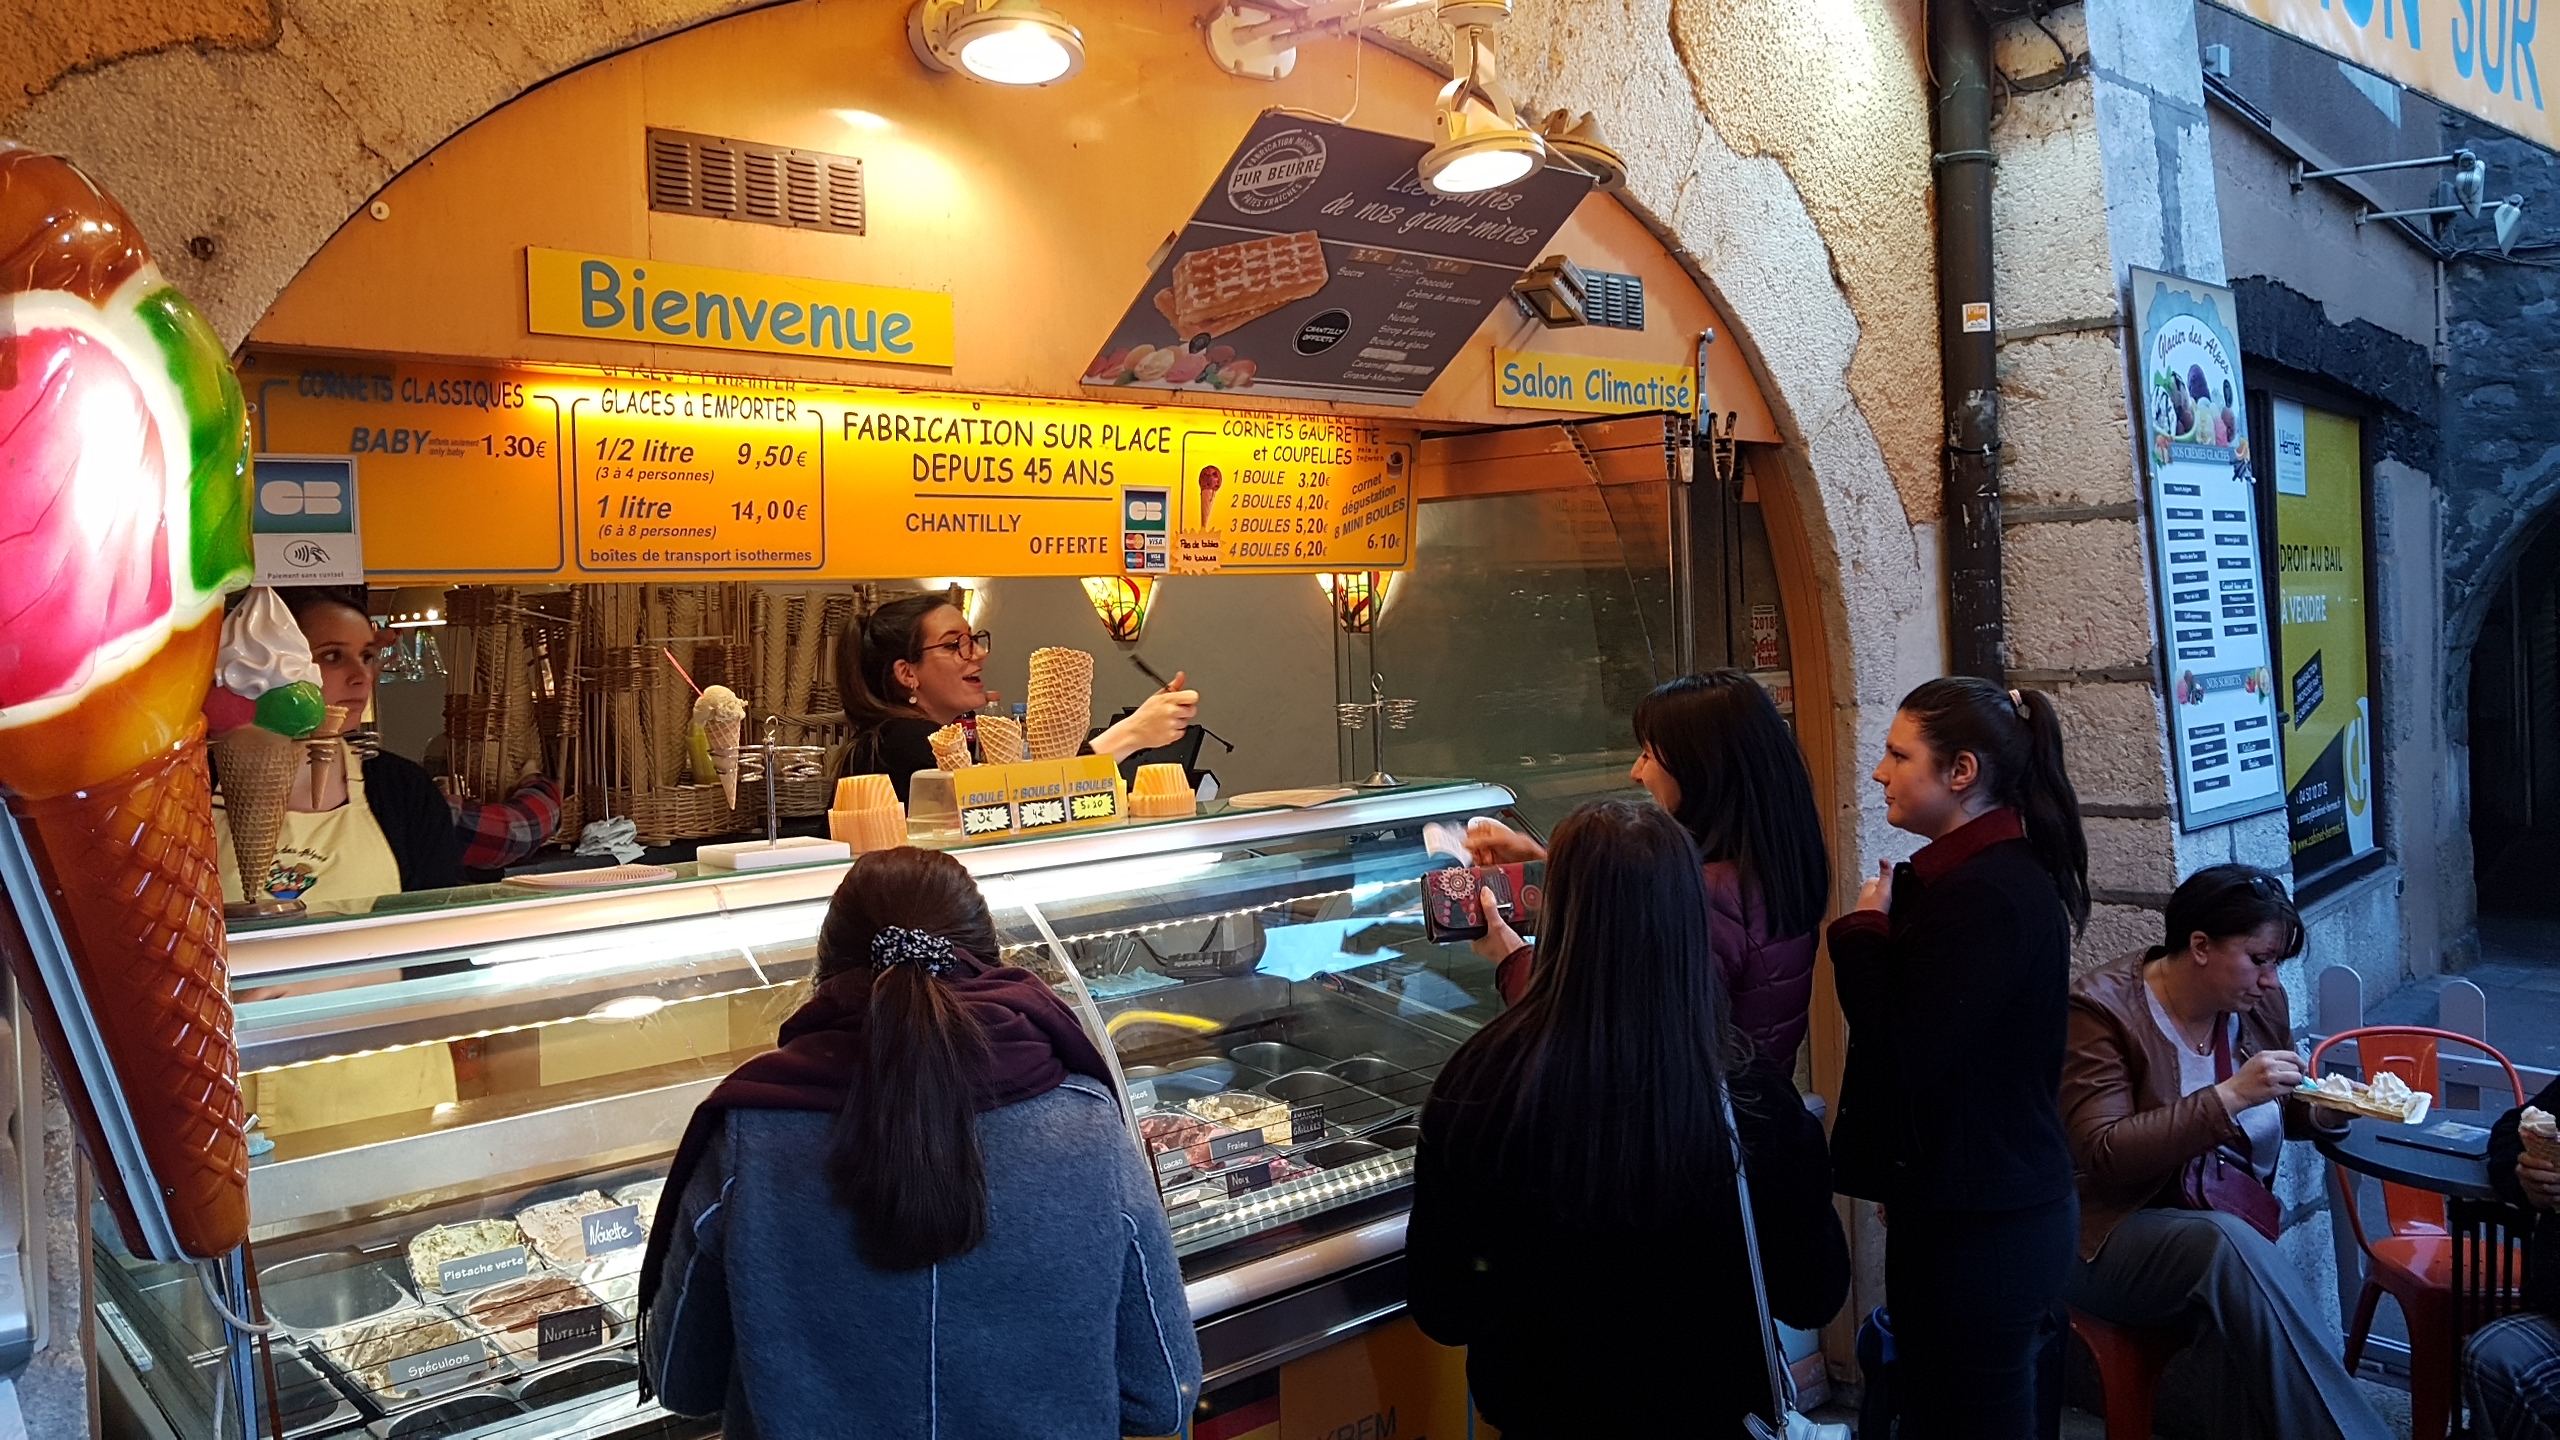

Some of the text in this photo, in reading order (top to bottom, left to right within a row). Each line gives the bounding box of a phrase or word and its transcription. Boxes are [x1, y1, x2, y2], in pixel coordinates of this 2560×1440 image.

[2452, 0, 2544, 111] SUR
[1247, 136, 1295, 167] FABRICATION
[1232, 157, 1324, 188] PUR BEURRE
[1387, 167, 1427, 196] Les
[1320, 191, 1538, 245] de nos grand-mères
[1336, 266, 1365, 278] Sucre
[1415, 276, 1454, 289] Chocolat
[1434, 292, 1445, 301] de
[580, 259, 914, 355] Bienvenue
[1397, 301, 1417, 311] Miel
[1387, 312, 1420, 324] Nutella
[1301, 334, 1337, 344] OFFERTE
[1305, 325, 1346, 336] CHANTILLY
[1378, 325, 1403, 337] Sirop
[1369, 336, 1430, 351] Boule de glace
[2157, 325, 2229, 375] Glacier des Alpes
[1351, 359, 1387, 370] Caramel
[1342, 370, 1405, 383] Grand-Marnier
[1502, 362, 1690, 408] Salon Climatisé
[401, 377, 524, 413] CLASSIQUES
[601, 387, 797, 422] GLACES à EMPORTER
[351, 426, 432, 455] BABY
[843, 411, 1172, 454] FABRICATION SUR PLACE
[1223, 419, 1380, 445] CORNETS GAUFRETTE
[595, 437, 635, 462] 1/2
[642, 438, 694, 463] litre
[1253, 446, 1352, 465] et COUPELLES
[2171, 446, 2184, 459] NOS
[595, 466, 715, 484] (3 à 4 personnes)
[912, 453, 1115, 486] DEPUIS 45 ANS
[1233, 469, 1239, 484] 1
[1242, 470, 1285, 485] BOULE
[1351, 473, 1382, 495] cornet
[596, 494, 610, 519] 1
[619, 495, 672, 519] litre
[1230, 494, 1239, 508] 2
[1241, 494, 1292, 509] BOULES
[1341, 484, 1397, 516] dégustation
[905, 512, 1021, 533] CHANTILLY
[1230, 518, 1238, 533] 3
[1240, 518, 1291, 533] BOULES
[1334, 497, 1406, 540] 8 MINI BOULES
[598, 525, 717, 541] (6 à 8 personnes)
[1029, 536, 1108, 555] OFFERTE
[1180, 539, 1191, 549] Pas
[1192, 540, 1200, 548] de
[1229, 543, 1237, 556] 4
[1240, 542, 1290, 557] BOULES
[590, 549, 812, 564] boîtes de transport isothermes
[1182, 553, 1217, 562] No tables
[2280, 545, 2343, 572] DROIT AU BAIL
[2281, 588, 2327, 624] À VENDRE
[1754, 616, 1775, 630] 2018
[2206, 678, 2219, 690] NOS
[1013, 783, 1060, 800] 2 BOULES
[1075, 777, 1114, 792] BOULES
[962, 789, 1005, 806] 1 BOULE
[1226, 1140, 1249, 1151] Fraise
[1163, 1158, 1184, 1170] cacao
[1231, 1174, 1251, 1186] Noix
[589, 1219, 634, 1246] Noisette
[444, 1256, 524, 1282] Pistache verte
[544, 1324, 598, 1344] NUTELLA
[408, 1354, 471, 1378] Spéculoos
